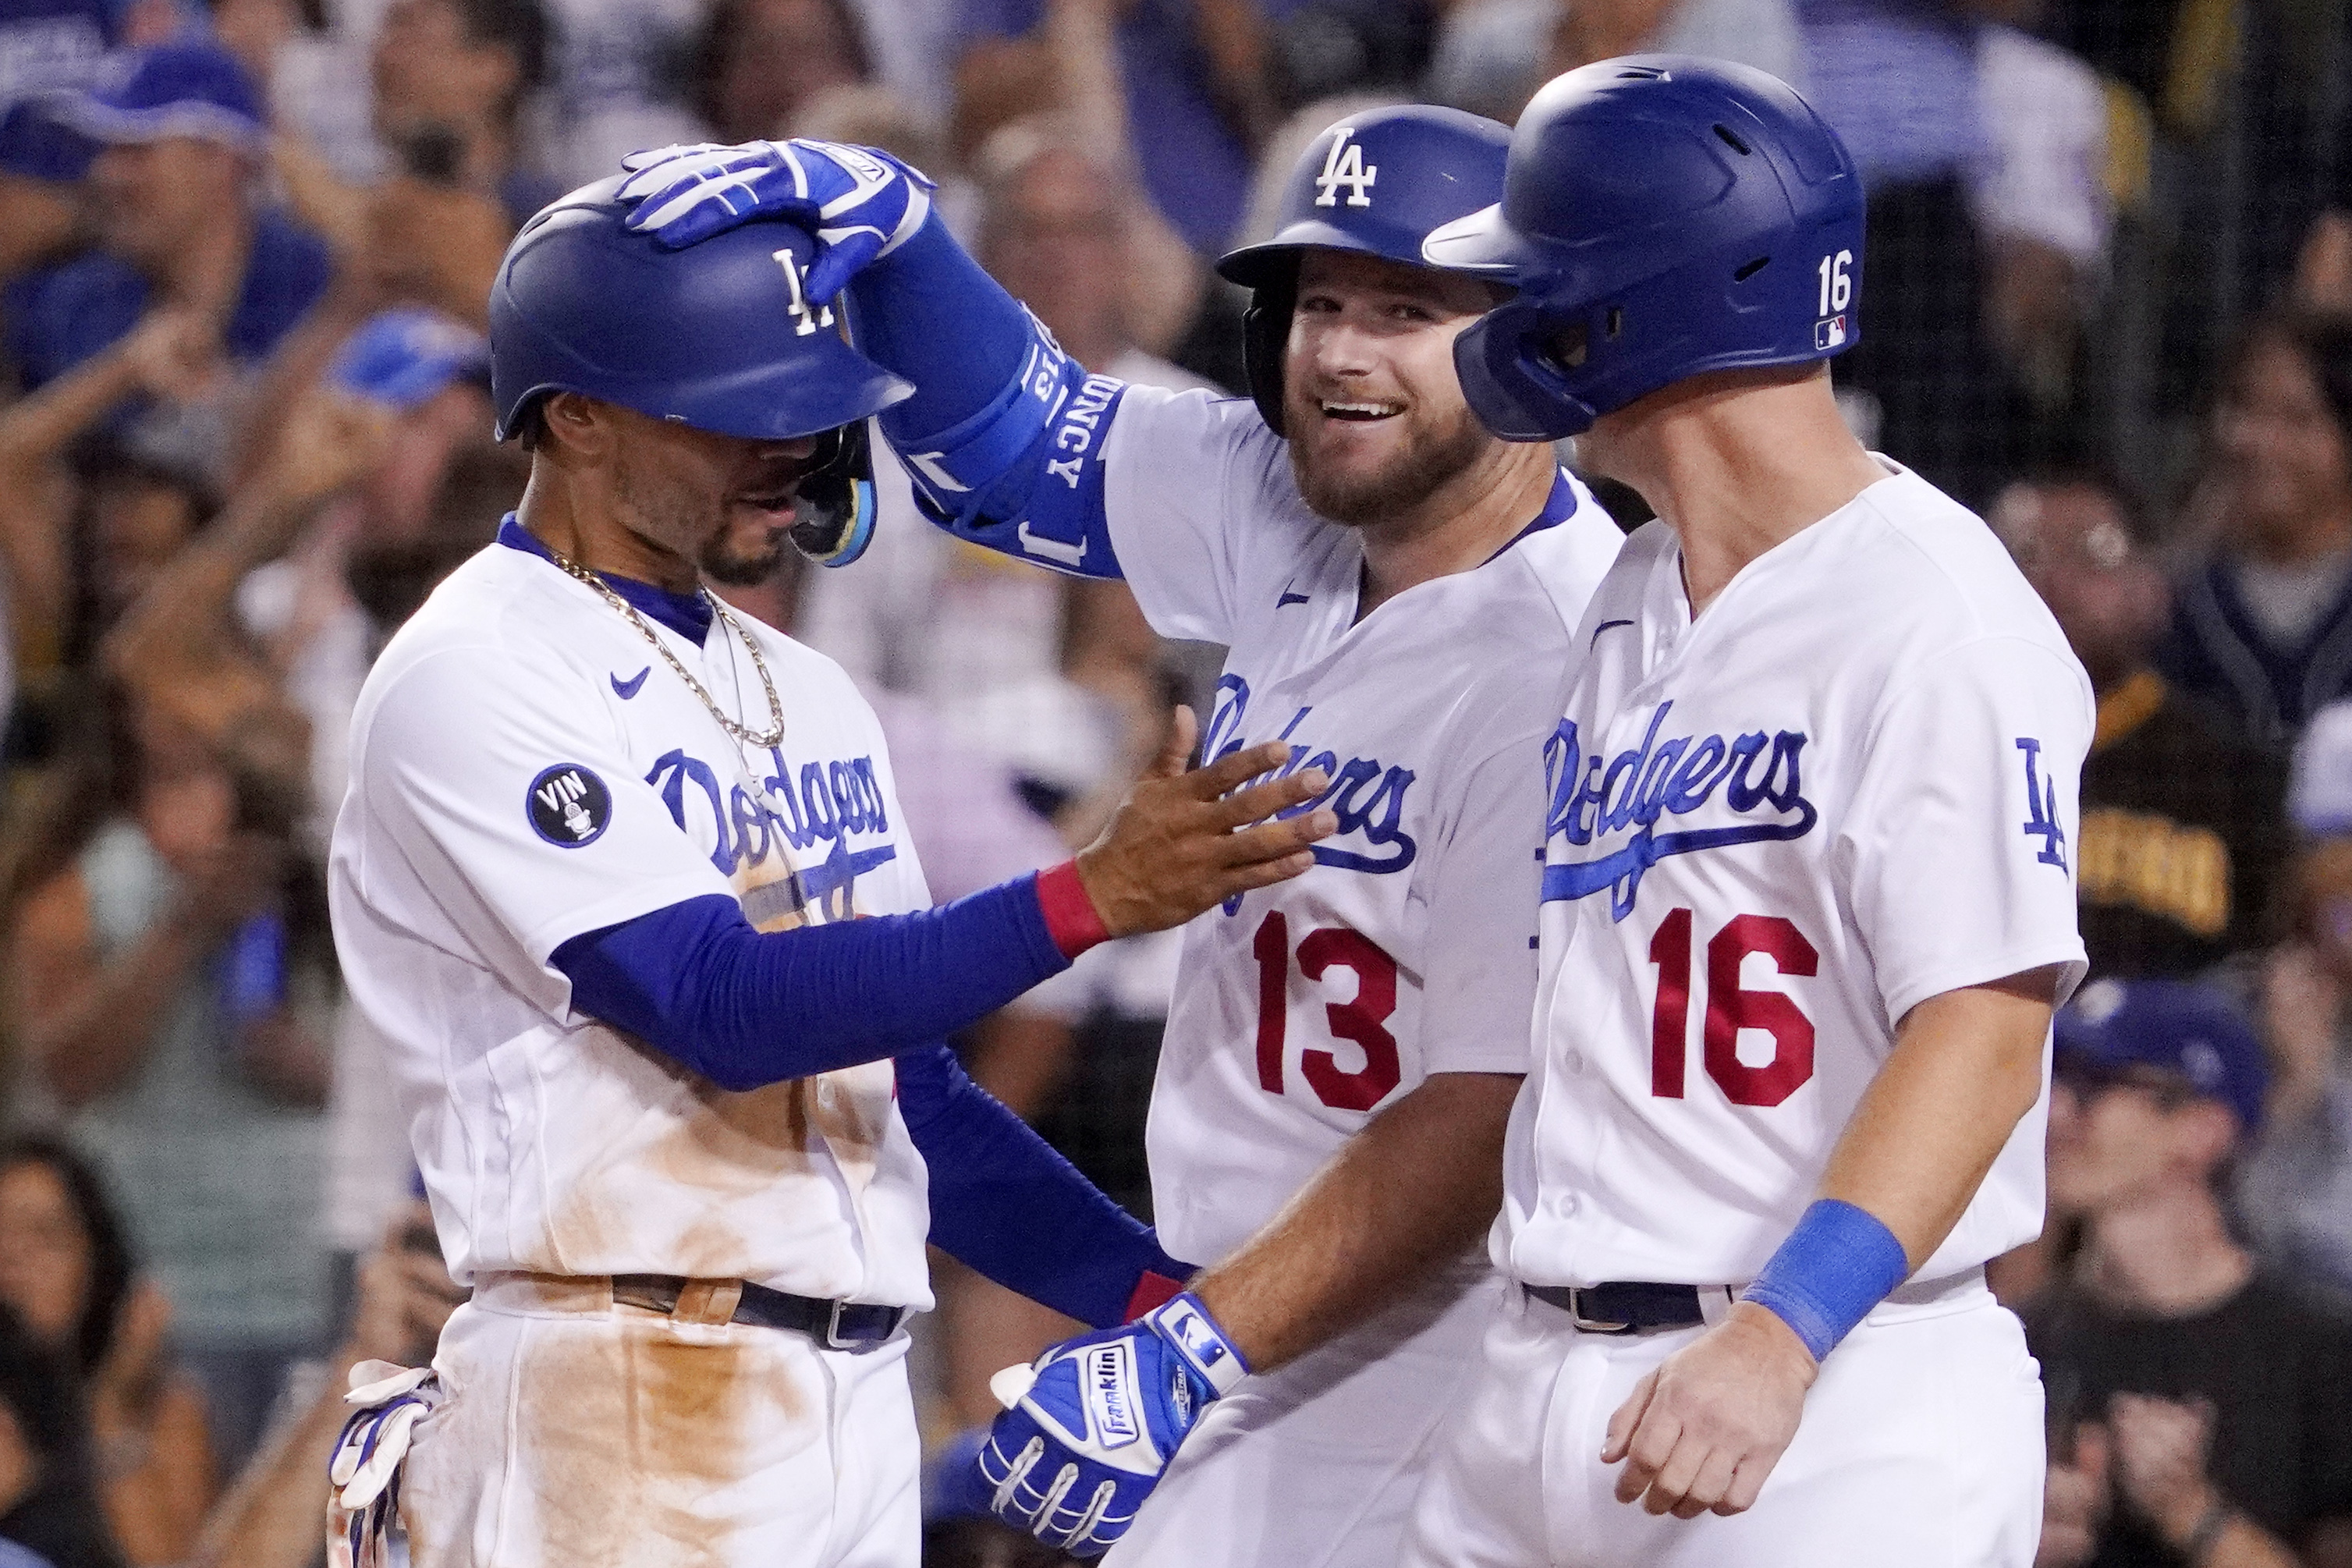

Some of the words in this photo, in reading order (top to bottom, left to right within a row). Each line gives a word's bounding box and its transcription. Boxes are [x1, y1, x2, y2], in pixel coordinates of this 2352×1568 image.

[1315, 127, 1377, 207] LA
[1818, 249, 1853, 317] 16
[1034, 352, 1059, 403] 13
[536, 770, 587, 811] VIN
[1201, 673, 1417, 917] Ders
[1540, 700, 1818, 923] Dodgers
[2015, 737, 2070, 884] LA
[1253, 910, 1401, 1112] 13
[1649, 907, 1819, 1107] 16
[1097, 1352, 1134, 1435] Franklin
